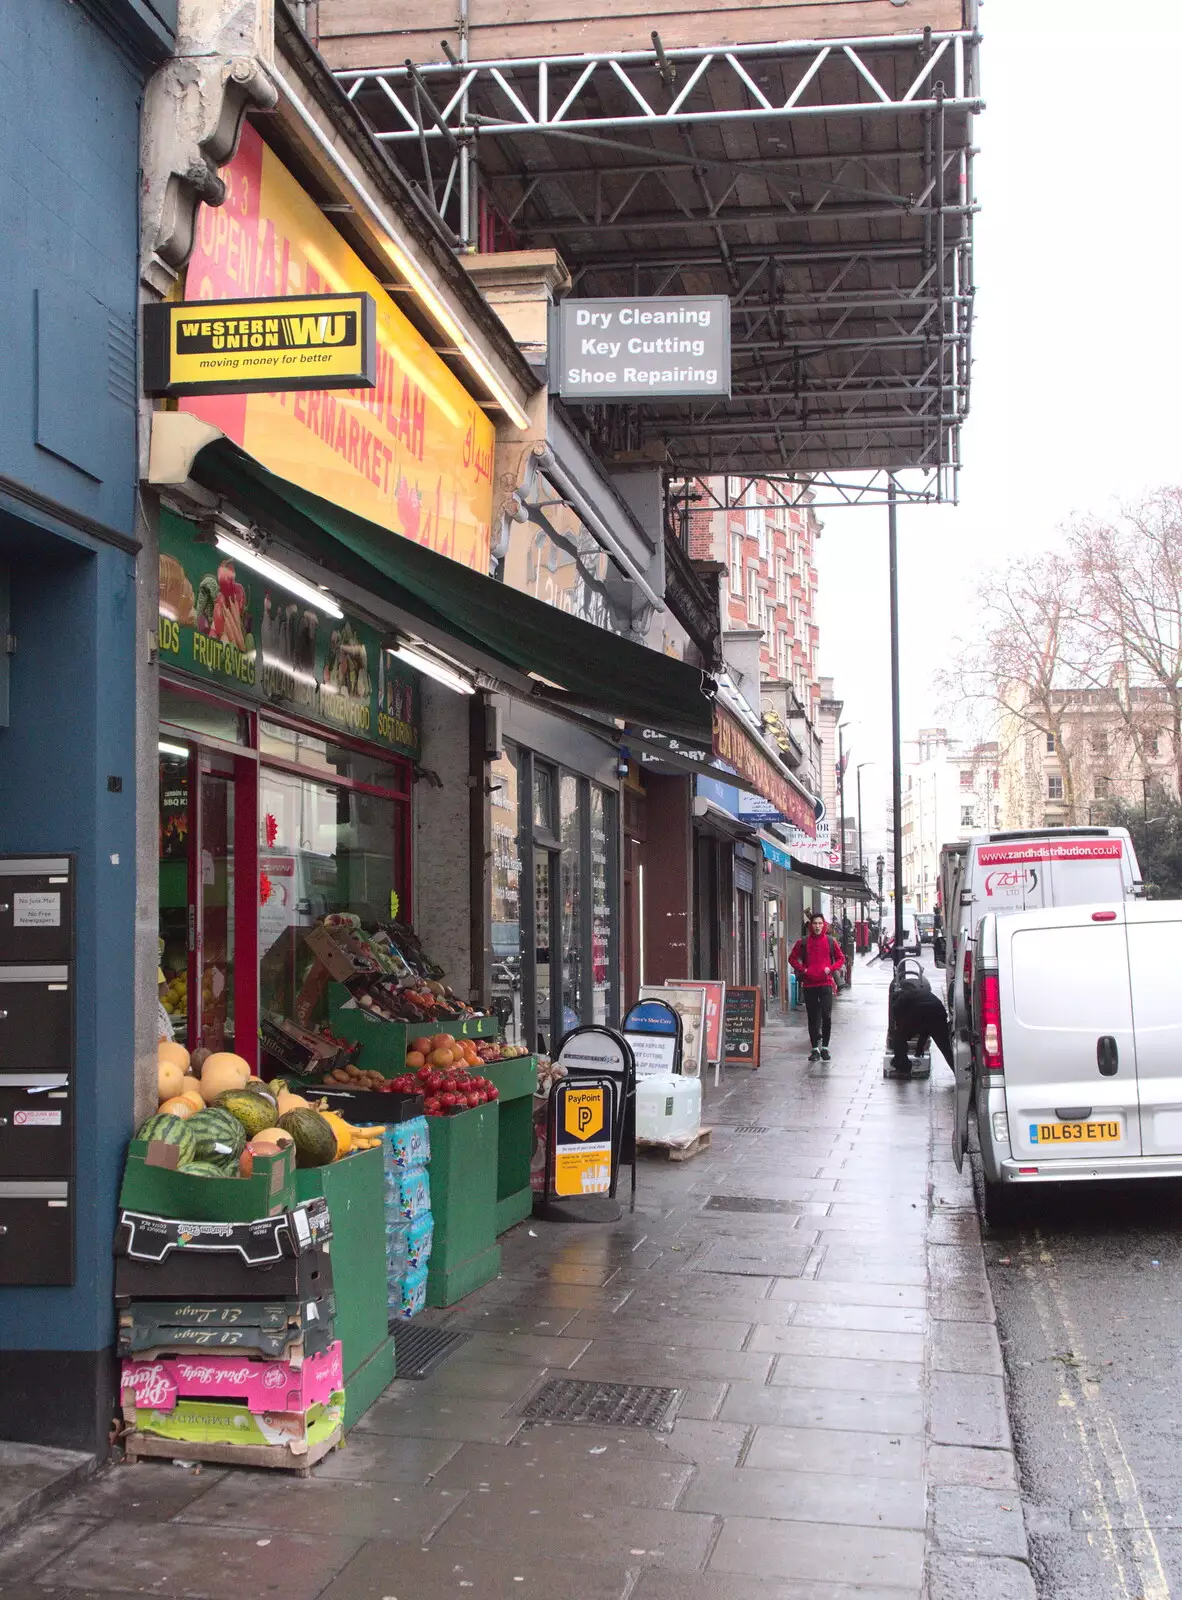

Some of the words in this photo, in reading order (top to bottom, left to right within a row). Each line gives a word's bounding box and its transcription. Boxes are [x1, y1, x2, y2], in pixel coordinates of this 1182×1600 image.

[240, 175, 249, 217] 3
[200, 199, 252, 294] OPEN
[182, 318, 279, 337] WESTERN
[576, 309, 612, 329] Dry
[618, 307, 711, 327] Cleaning
[212, 332, 279, 349] UNION
[288, 314, 347, 345] WU
[581, 338, 621, 358] Key
[627, 337, 705, 356] Cutting
[200, 357, 239, 368] moving
[242, 355, 279, 367] money
[282, 354, 297, 364] for
[300, 353, 333, 363] better
[568, 368, 617, 384] Shoe
[623, 366, 718, 385] Repairing
[193, 631, 223, 670] FRUIT
[669, 739, 680, 749] &
[981, 844, 1119, 862] www.zandhdistribution.co.uk
[568, 1094, 601, 1104] PayPoint
[1041, 1125, 1083, 1140] DL63
[1087, 1123, 1118, 1139] ETU
[174, 1306, 217, 1323] Lago
[220, 1308, 242, 1321] El
[174, 1330, 218, 1345] Lago
[220, 1331, 243, 1344] El
[177, 1363, 214, 1385] Lady
[215, 1366, 259, 1385] Pink
[135, 1377, 178, 1405] Pin
